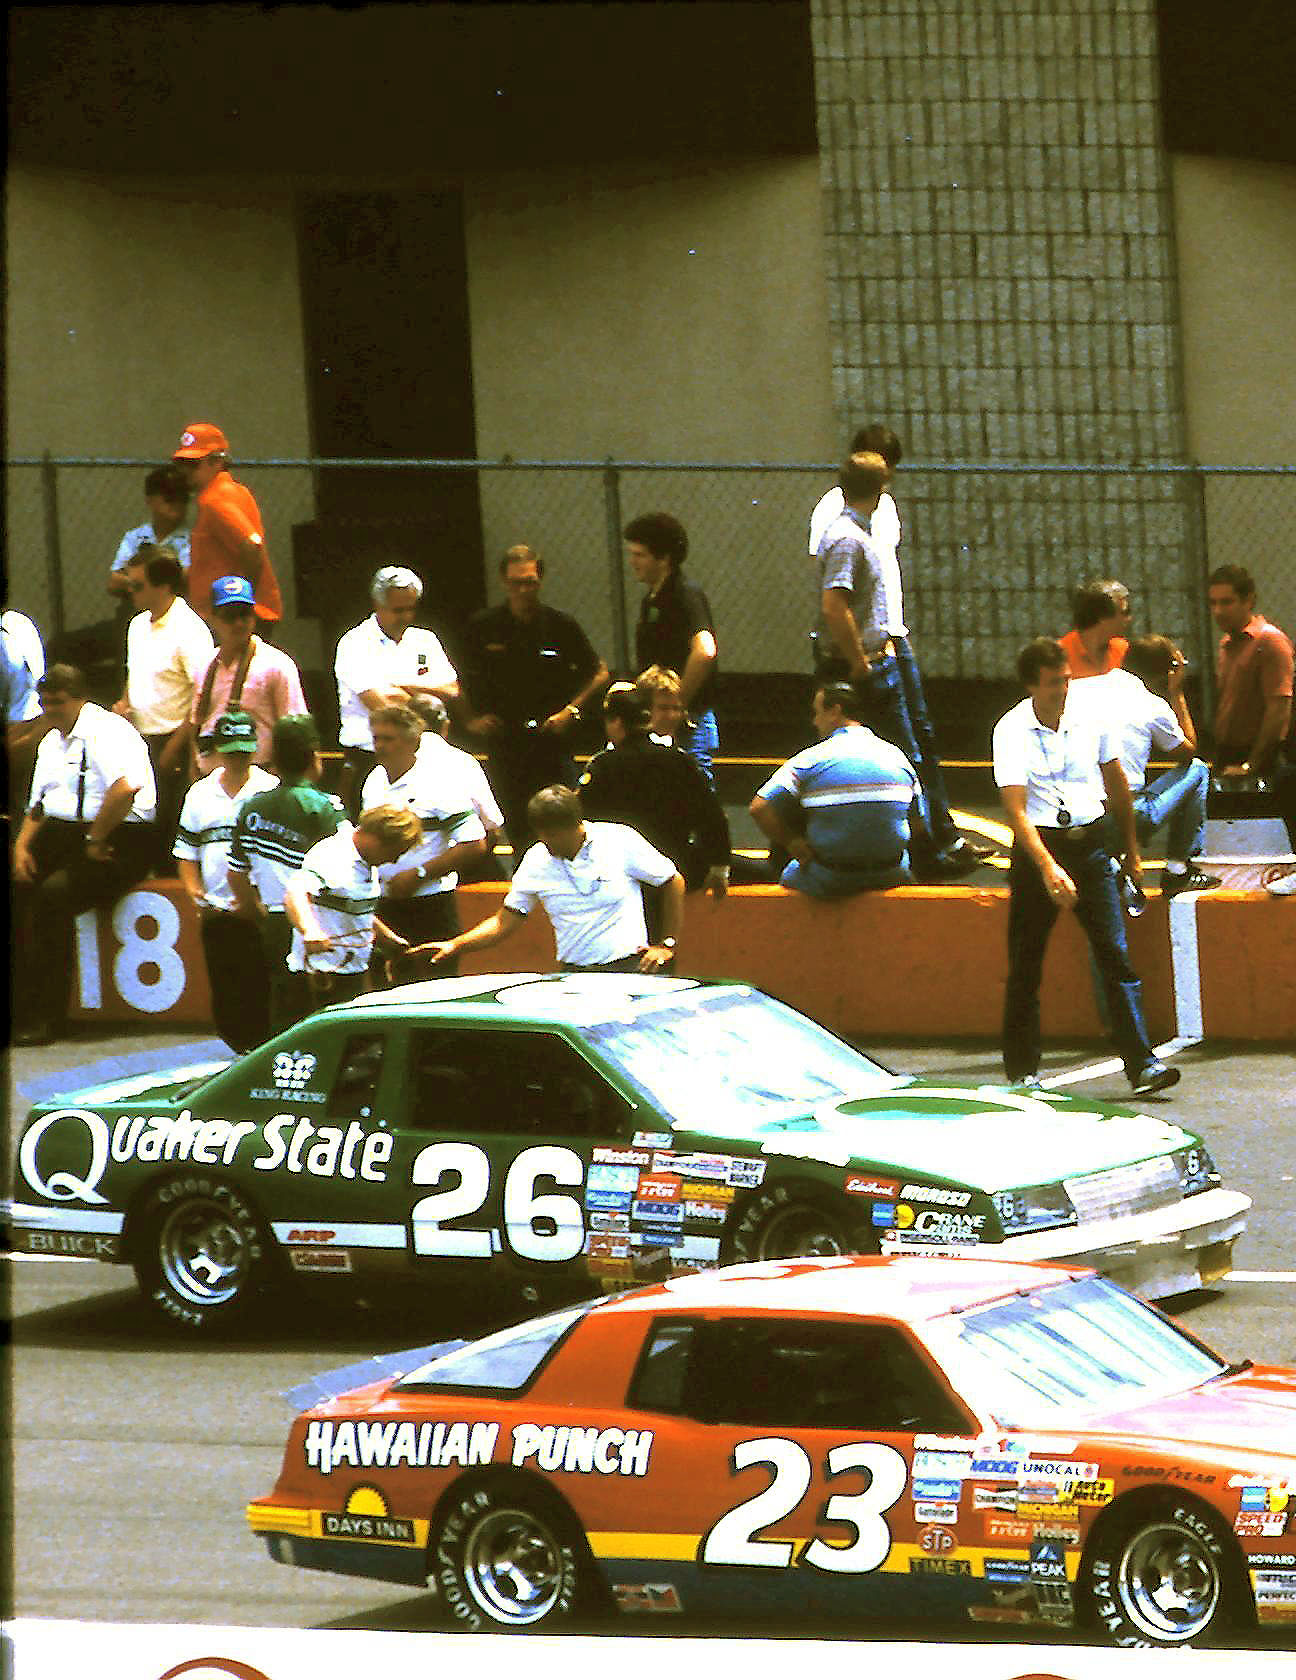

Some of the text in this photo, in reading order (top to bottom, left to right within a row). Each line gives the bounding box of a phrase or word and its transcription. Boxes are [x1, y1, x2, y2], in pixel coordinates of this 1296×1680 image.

[74, 891, 187, 1013] 18
[20, 1109, 394, 1204] Quaker State
[411, 1142, 587, 1261] 26
[28, 1232, 117, 1256] BUICK
[305, 1421, 655, 1478] HAWAIIAN PUNCH
[970, 1459, 1019, 1474] MOOG
[1022, 1462, 1081, 1477] UNOCAL
[702, 1435, 910, 1574] 23
[326, 1517, 410, 1539] DAYS INN
[922, 1529, 953, 1551] STP
[911, 1560, 971, 1576] TIMEX
[1030, 1561, 1065, 1577] PEAK
